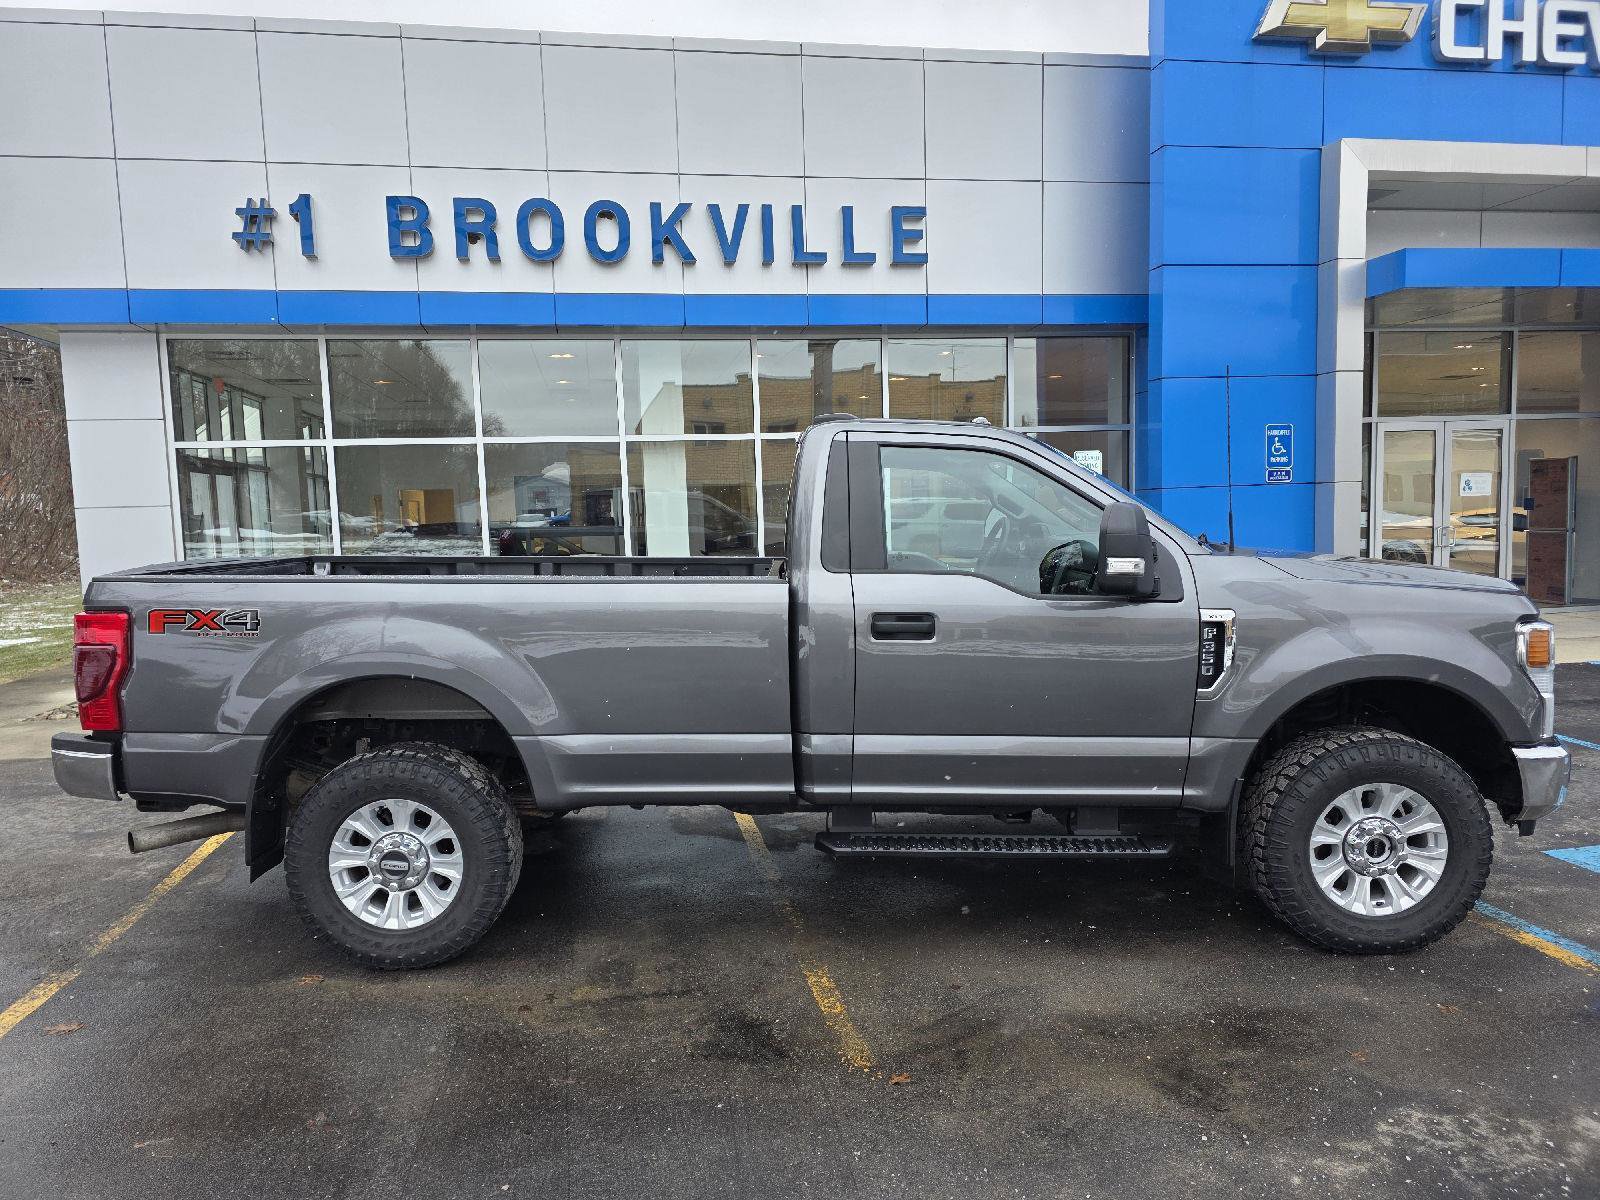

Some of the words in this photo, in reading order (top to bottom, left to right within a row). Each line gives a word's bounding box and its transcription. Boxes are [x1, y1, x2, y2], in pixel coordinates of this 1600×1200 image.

[1438, 0, 1600, 66] CHE
[232, 194, 317, 258] #1
[386, 196, 928, 265] BROOKVILLE
[147, 608, 261, 635] FX4
